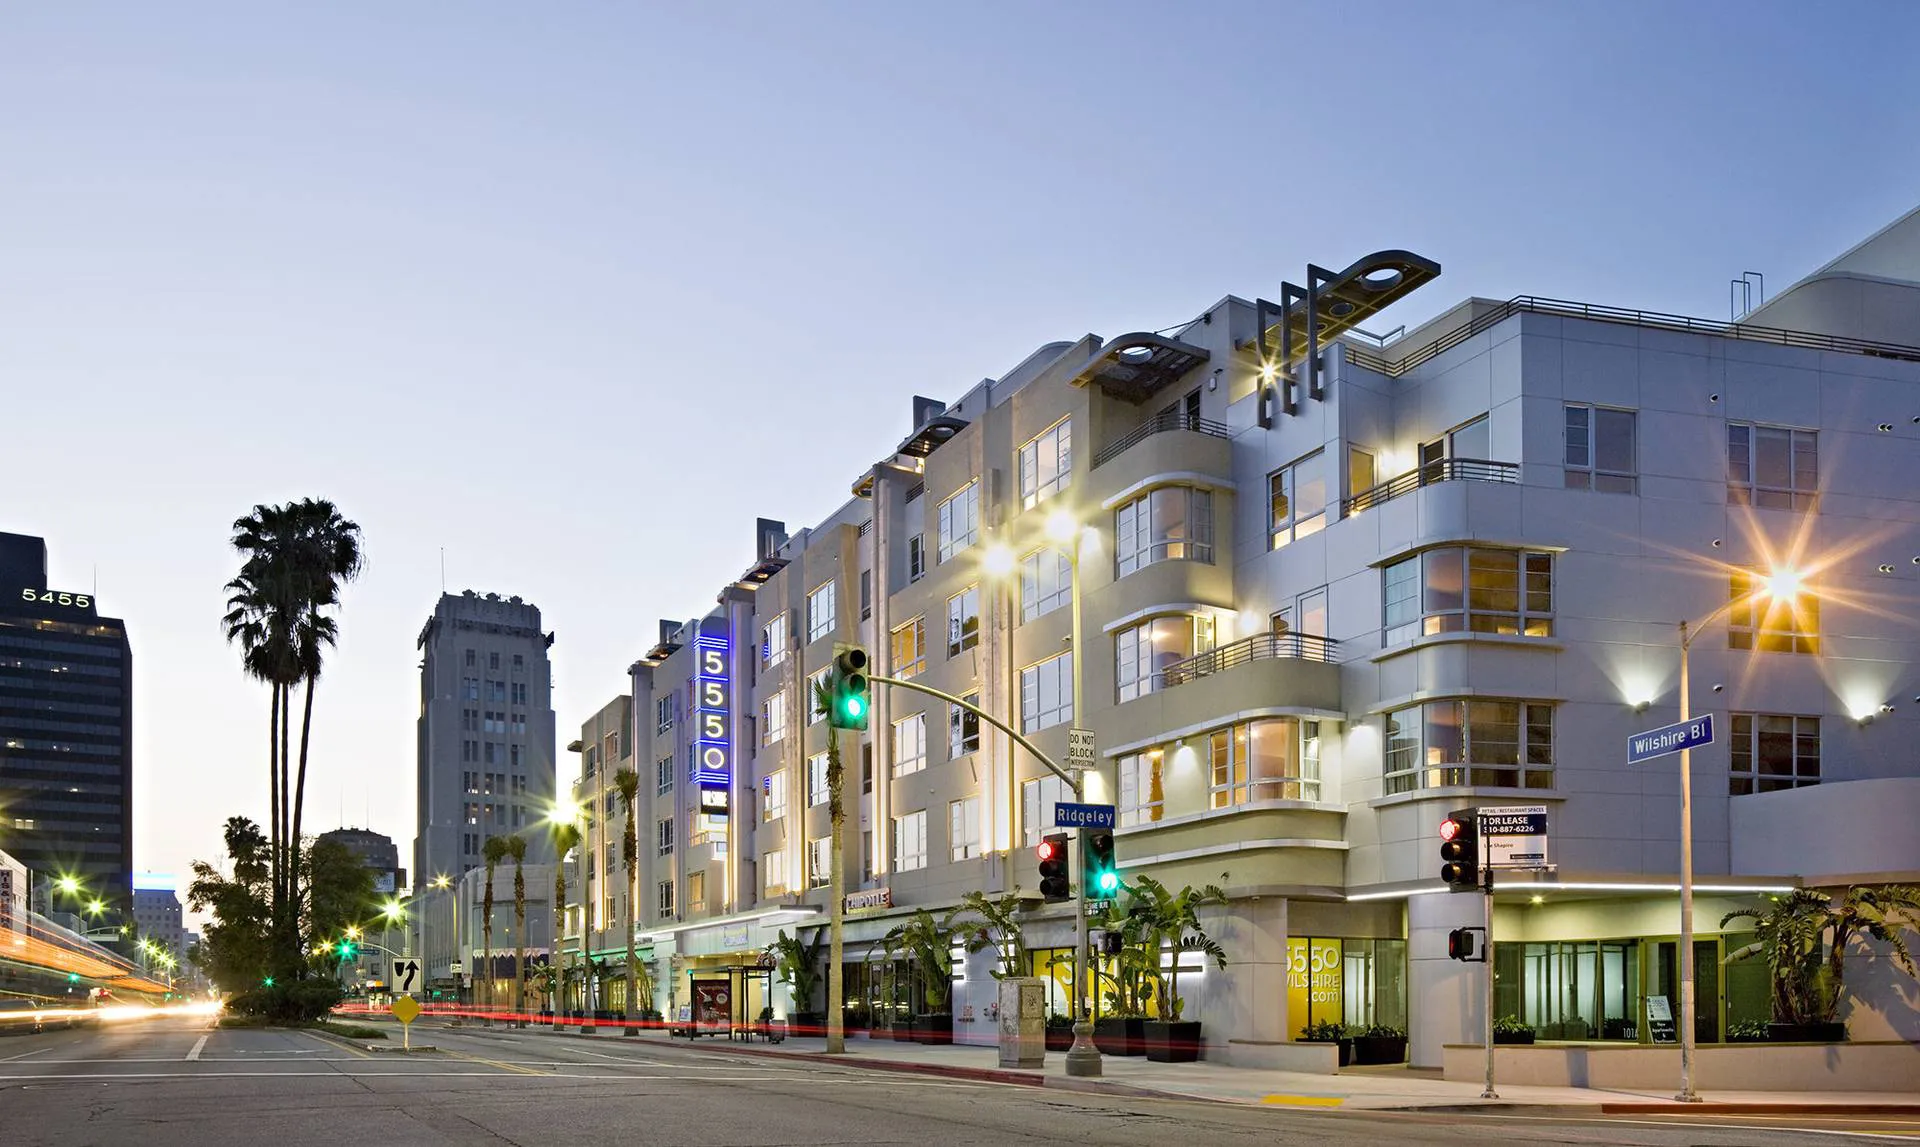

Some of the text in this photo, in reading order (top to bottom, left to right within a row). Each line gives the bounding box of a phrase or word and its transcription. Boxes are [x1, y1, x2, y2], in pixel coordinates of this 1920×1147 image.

[22, 588, 90, 608] 5455
[704, 650, 725, 770] 5550
[1070, 734, 1094, 746] DO NOT
[1635, 731, 1686, 754] Wilshire
[1070, 747, 1094, 759] BLOCK
[1057, 808, 1112, 826] Ridgeley
[1502, 816, 1528, 825] LEASE
[846, 892, 889, 908] CHIPOTLE
[1305, 991, 1338, 1003] .com
